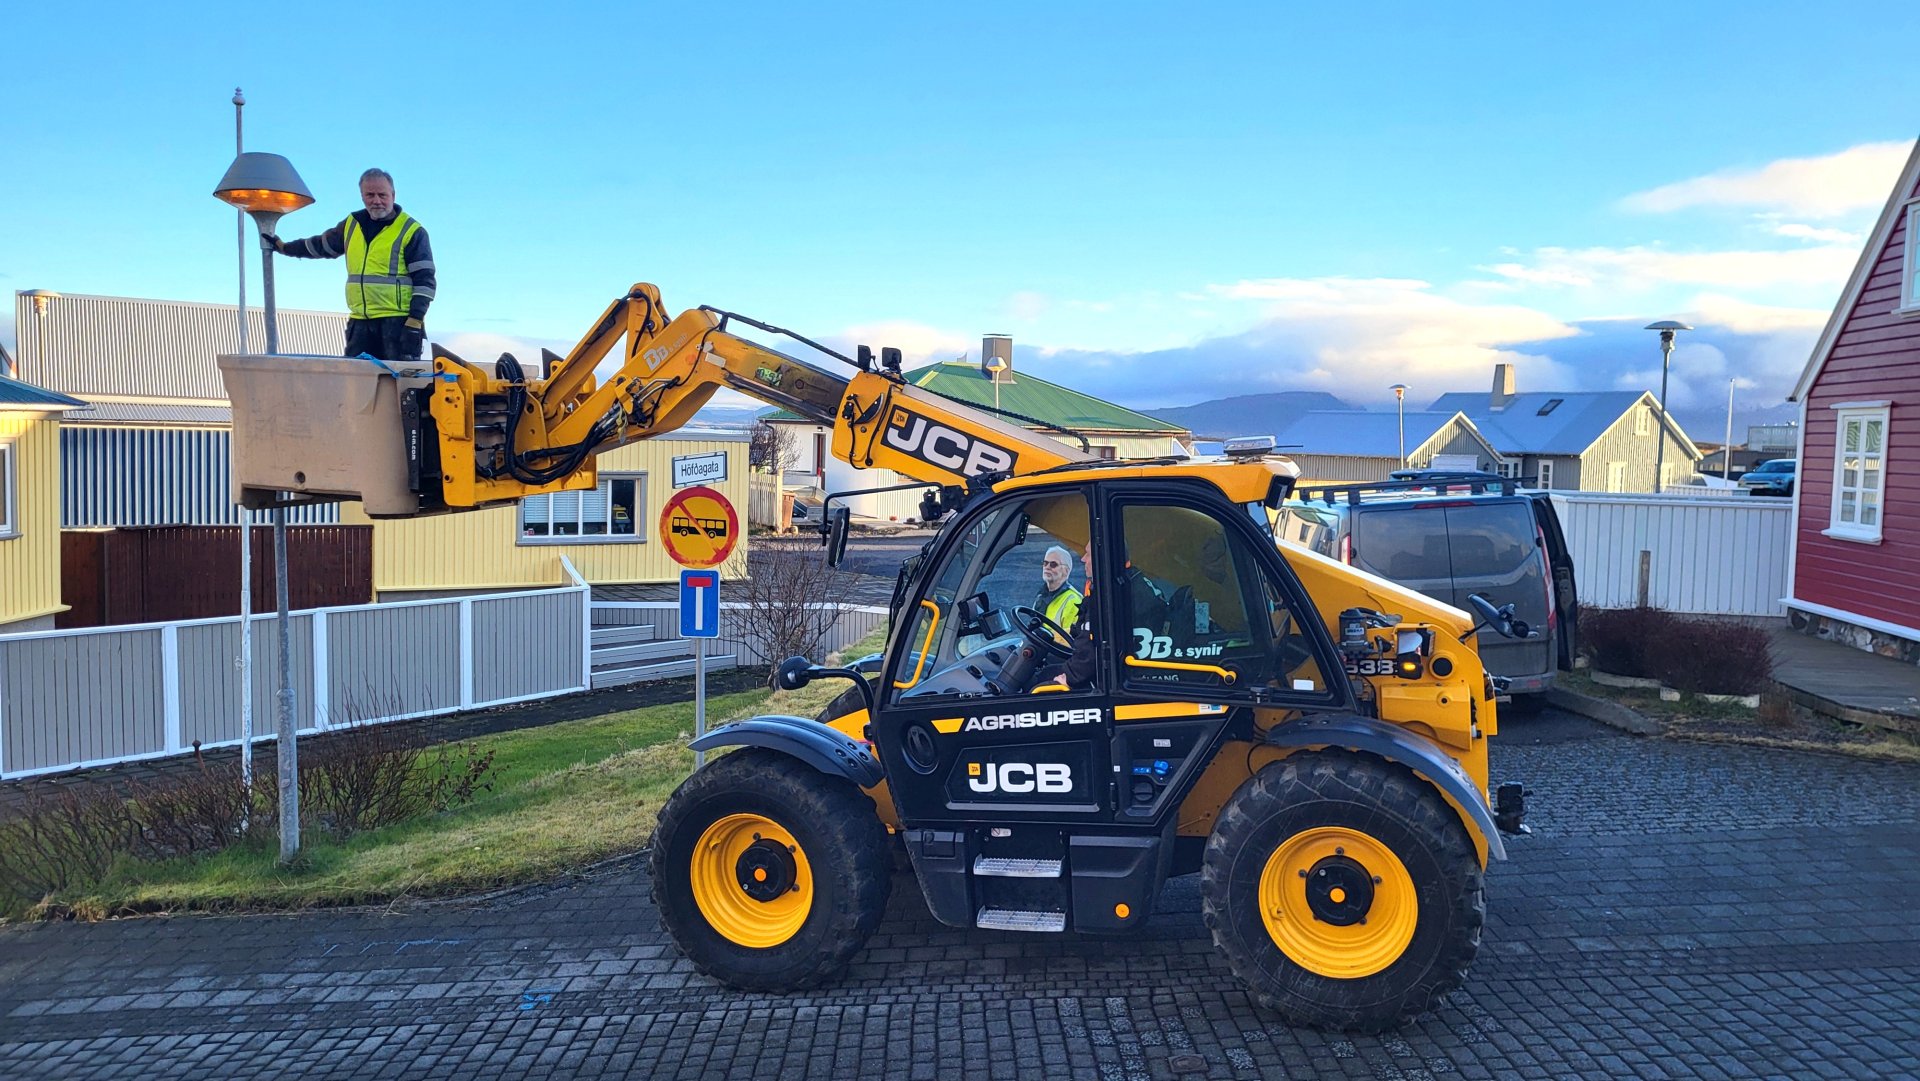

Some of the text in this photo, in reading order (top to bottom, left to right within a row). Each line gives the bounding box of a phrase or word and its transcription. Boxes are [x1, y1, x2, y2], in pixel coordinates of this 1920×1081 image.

[887, 417, 1012, 477] JCB
[681, 460, 719, 477] Höfðagata
[1174, 648, 1183, 657] &
[1186, 644, 1224, 659] synir
[964, 708, 1101, 732] AGRISUPER
[968, 762, 1073, 793] JCB
